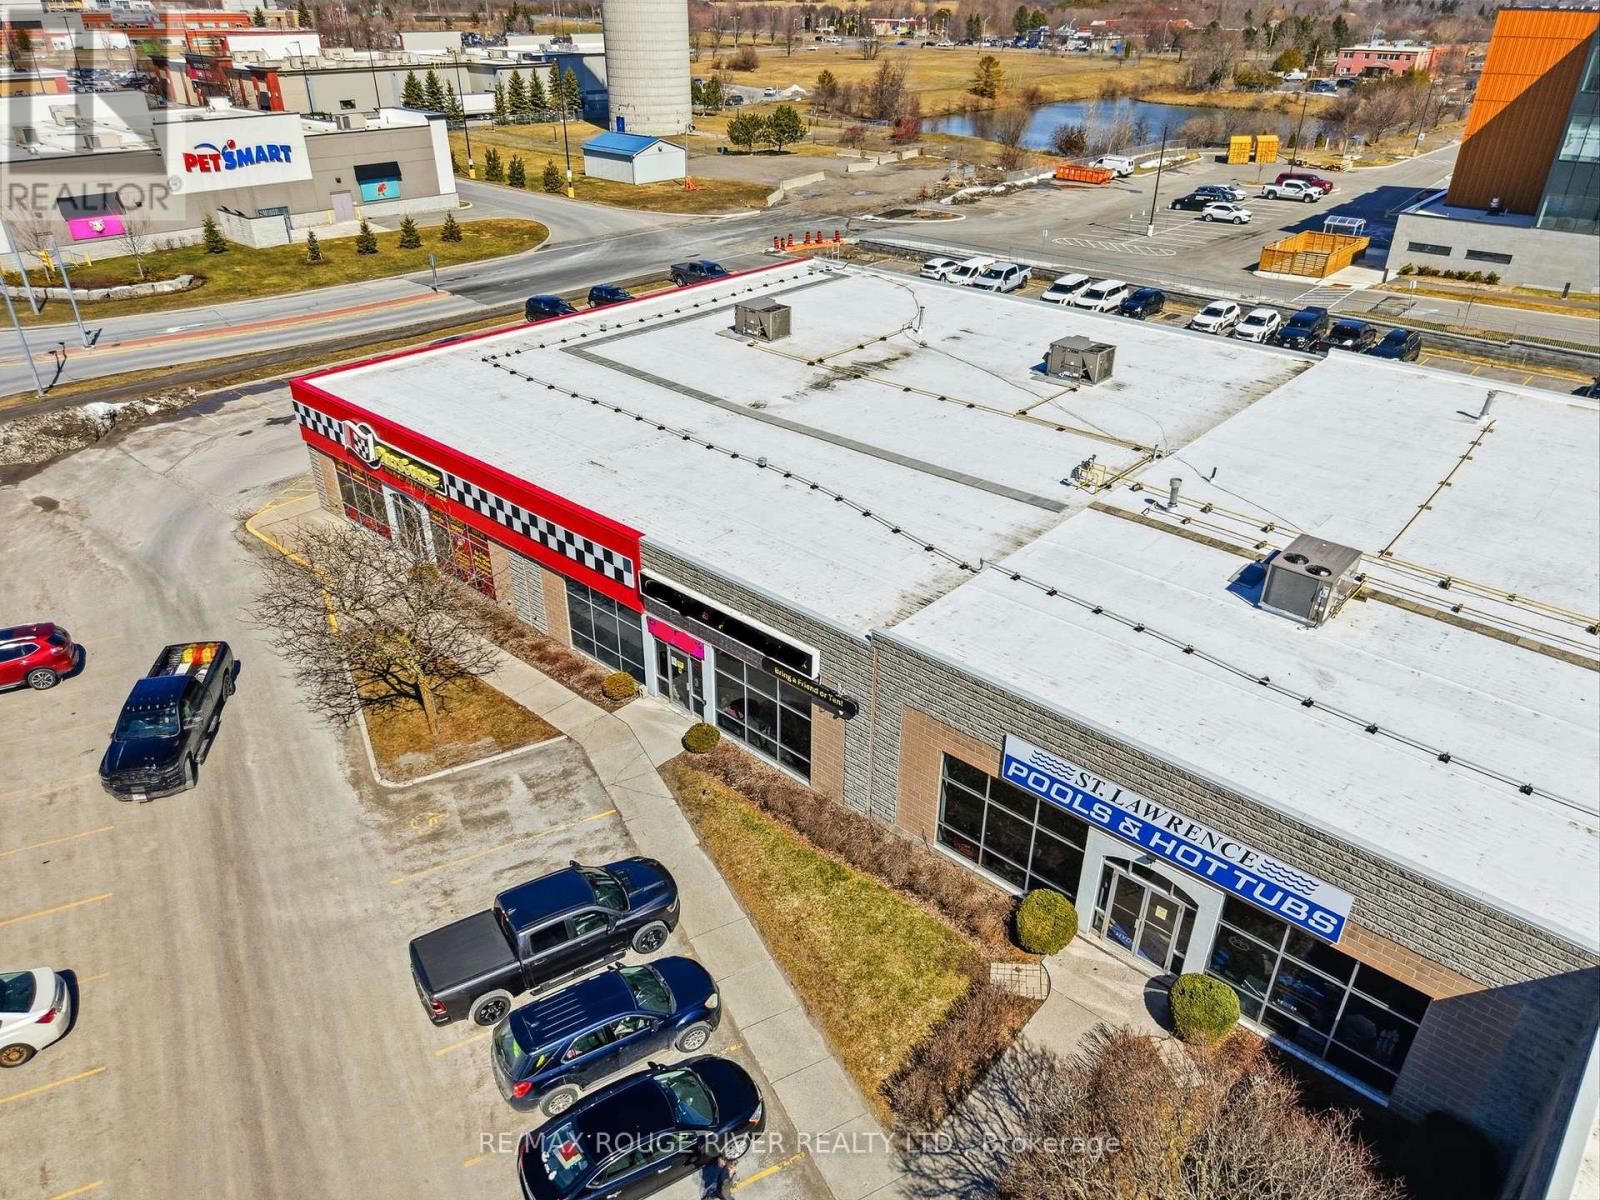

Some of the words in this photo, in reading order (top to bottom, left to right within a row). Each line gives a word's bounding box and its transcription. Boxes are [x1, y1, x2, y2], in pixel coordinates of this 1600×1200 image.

[182, 139, 292, 173] PETSMART
[797, 680, 819, 694] Friend
[1007, 761, 1112, 824] POOLS
[1118, 816, 1143, 842] &
[1148, 831, 1229, 877] HOT
[1233, 869, 1339, 935] TUBS
[1075, 770, 1106, 797] ST.
[1109, 789, 1260, 869] LAWRENCE
